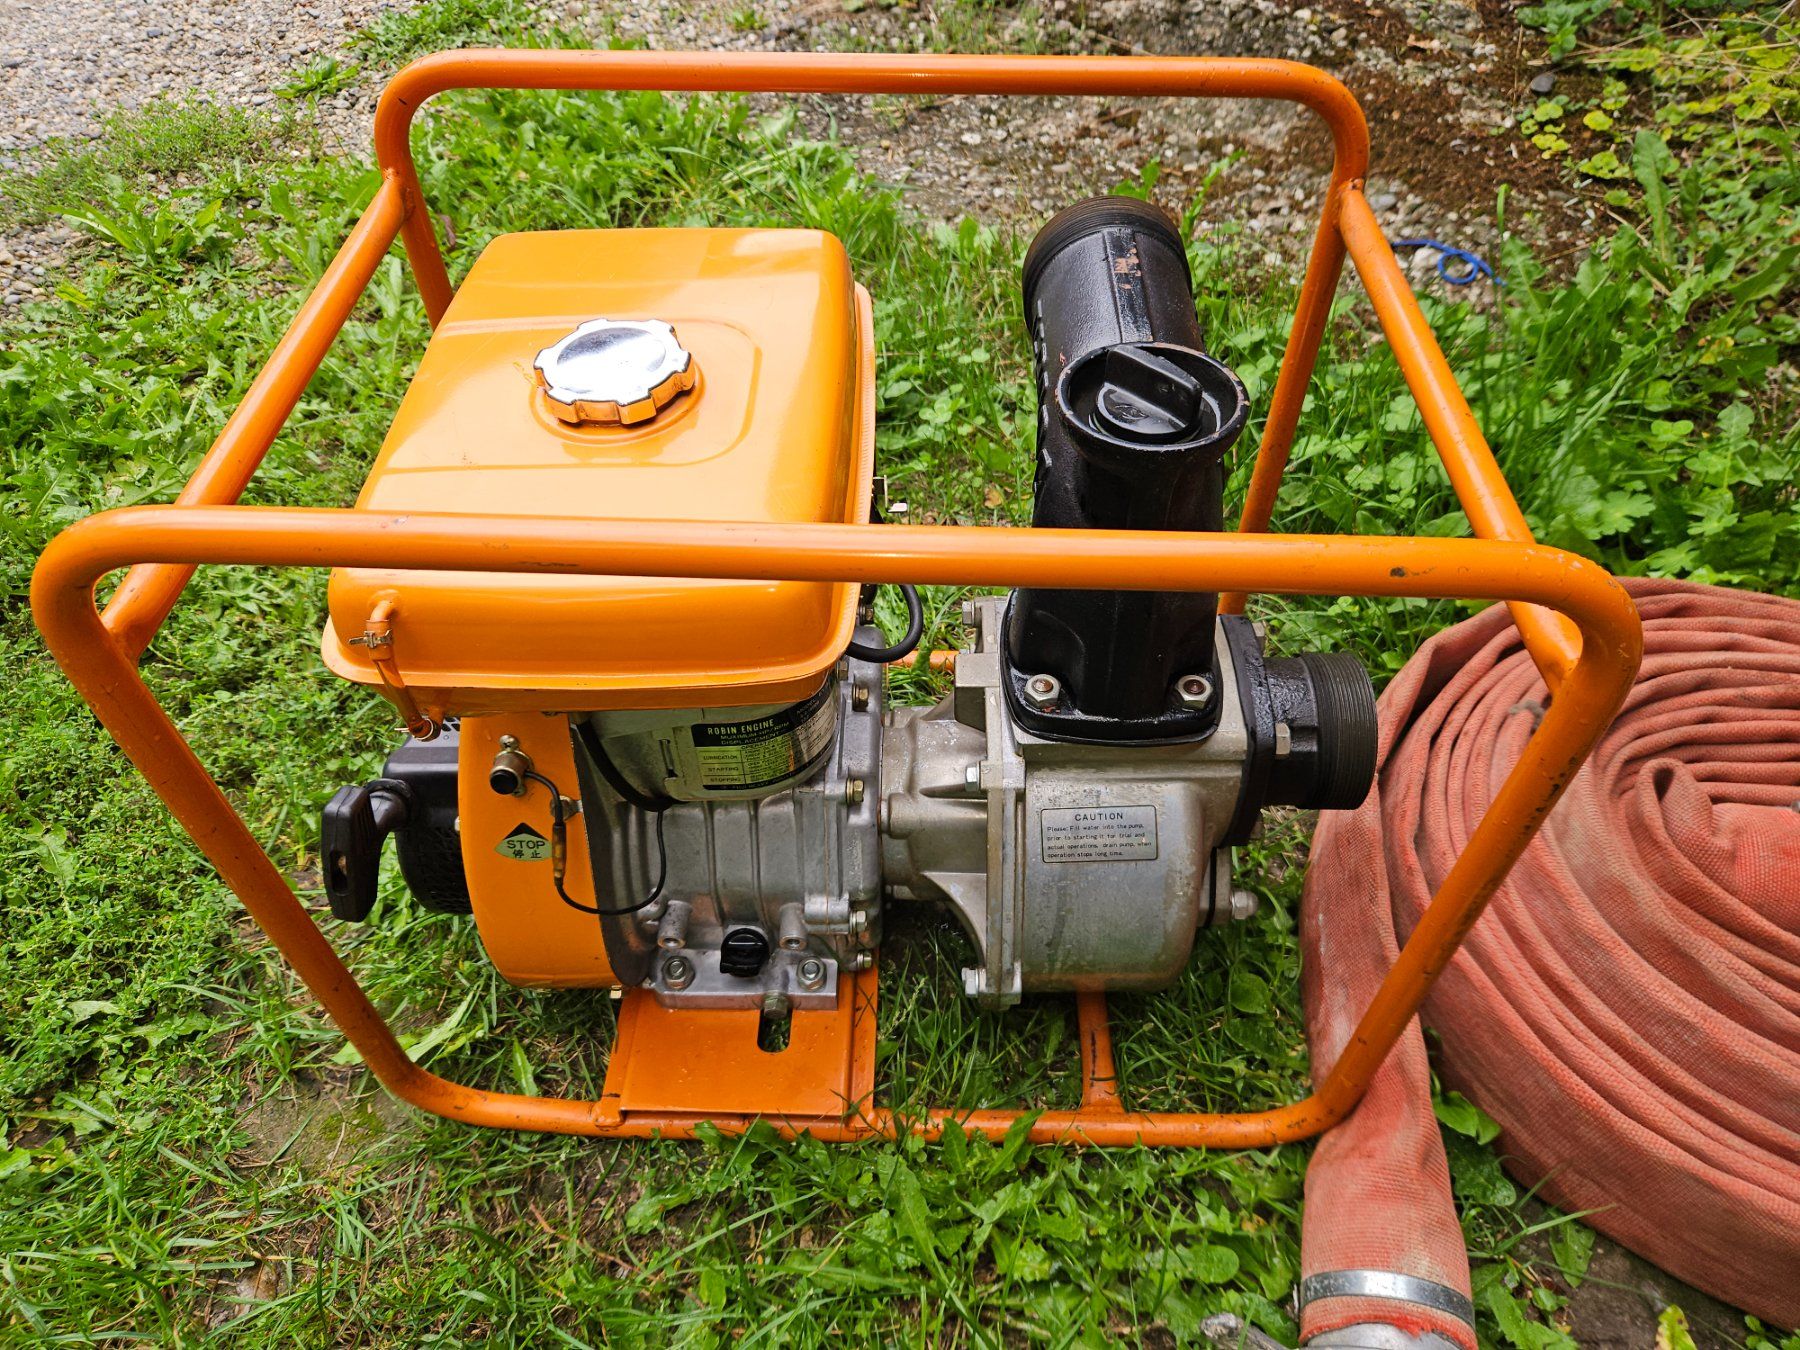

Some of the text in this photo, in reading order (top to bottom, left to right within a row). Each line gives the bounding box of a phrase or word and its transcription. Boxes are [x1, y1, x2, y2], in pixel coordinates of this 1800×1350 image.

[708, 719, 774, 735] ROBIN ENGINE
[1074, 812, 1124, 822] CAUTION
[507, 840, 545, 849] STOP
[513, 849, 542, 858] 停止
[1094, 850, 1108, 858] long
